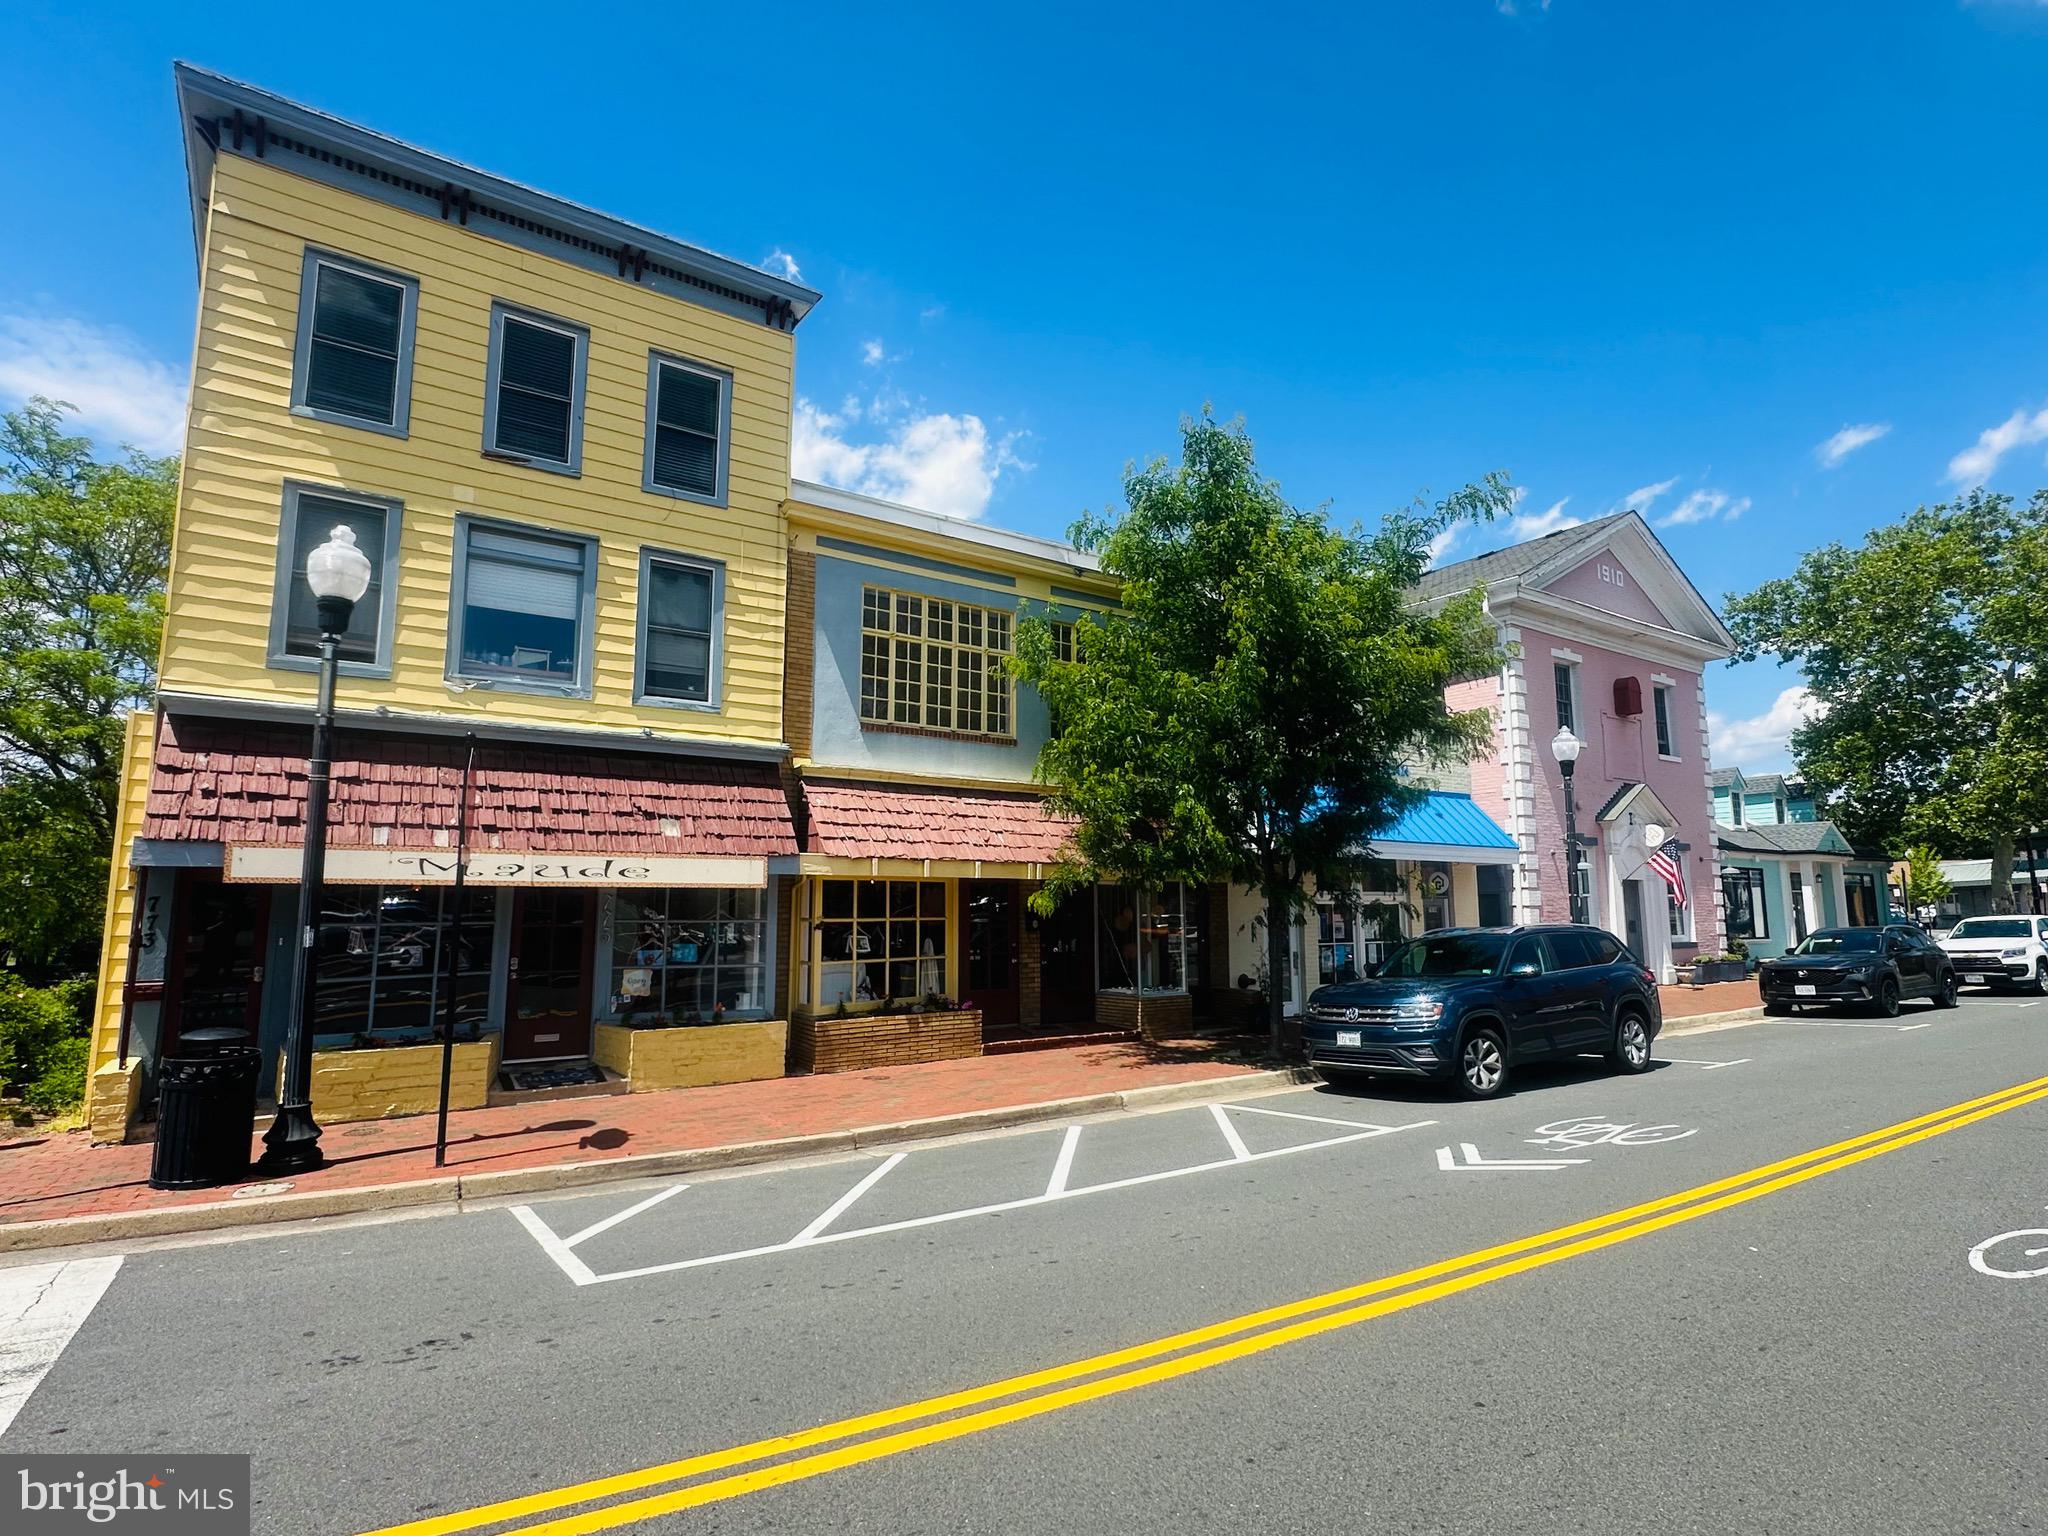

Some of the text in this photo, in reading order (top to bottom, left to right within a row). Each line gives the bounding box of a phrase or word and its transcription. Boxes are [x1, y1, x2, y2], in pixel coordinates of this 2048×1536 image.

[1597, 563, 1624, 587] 1910
[397, 857, 651, 879] Maude
[140, 896, 161, 948] 773
